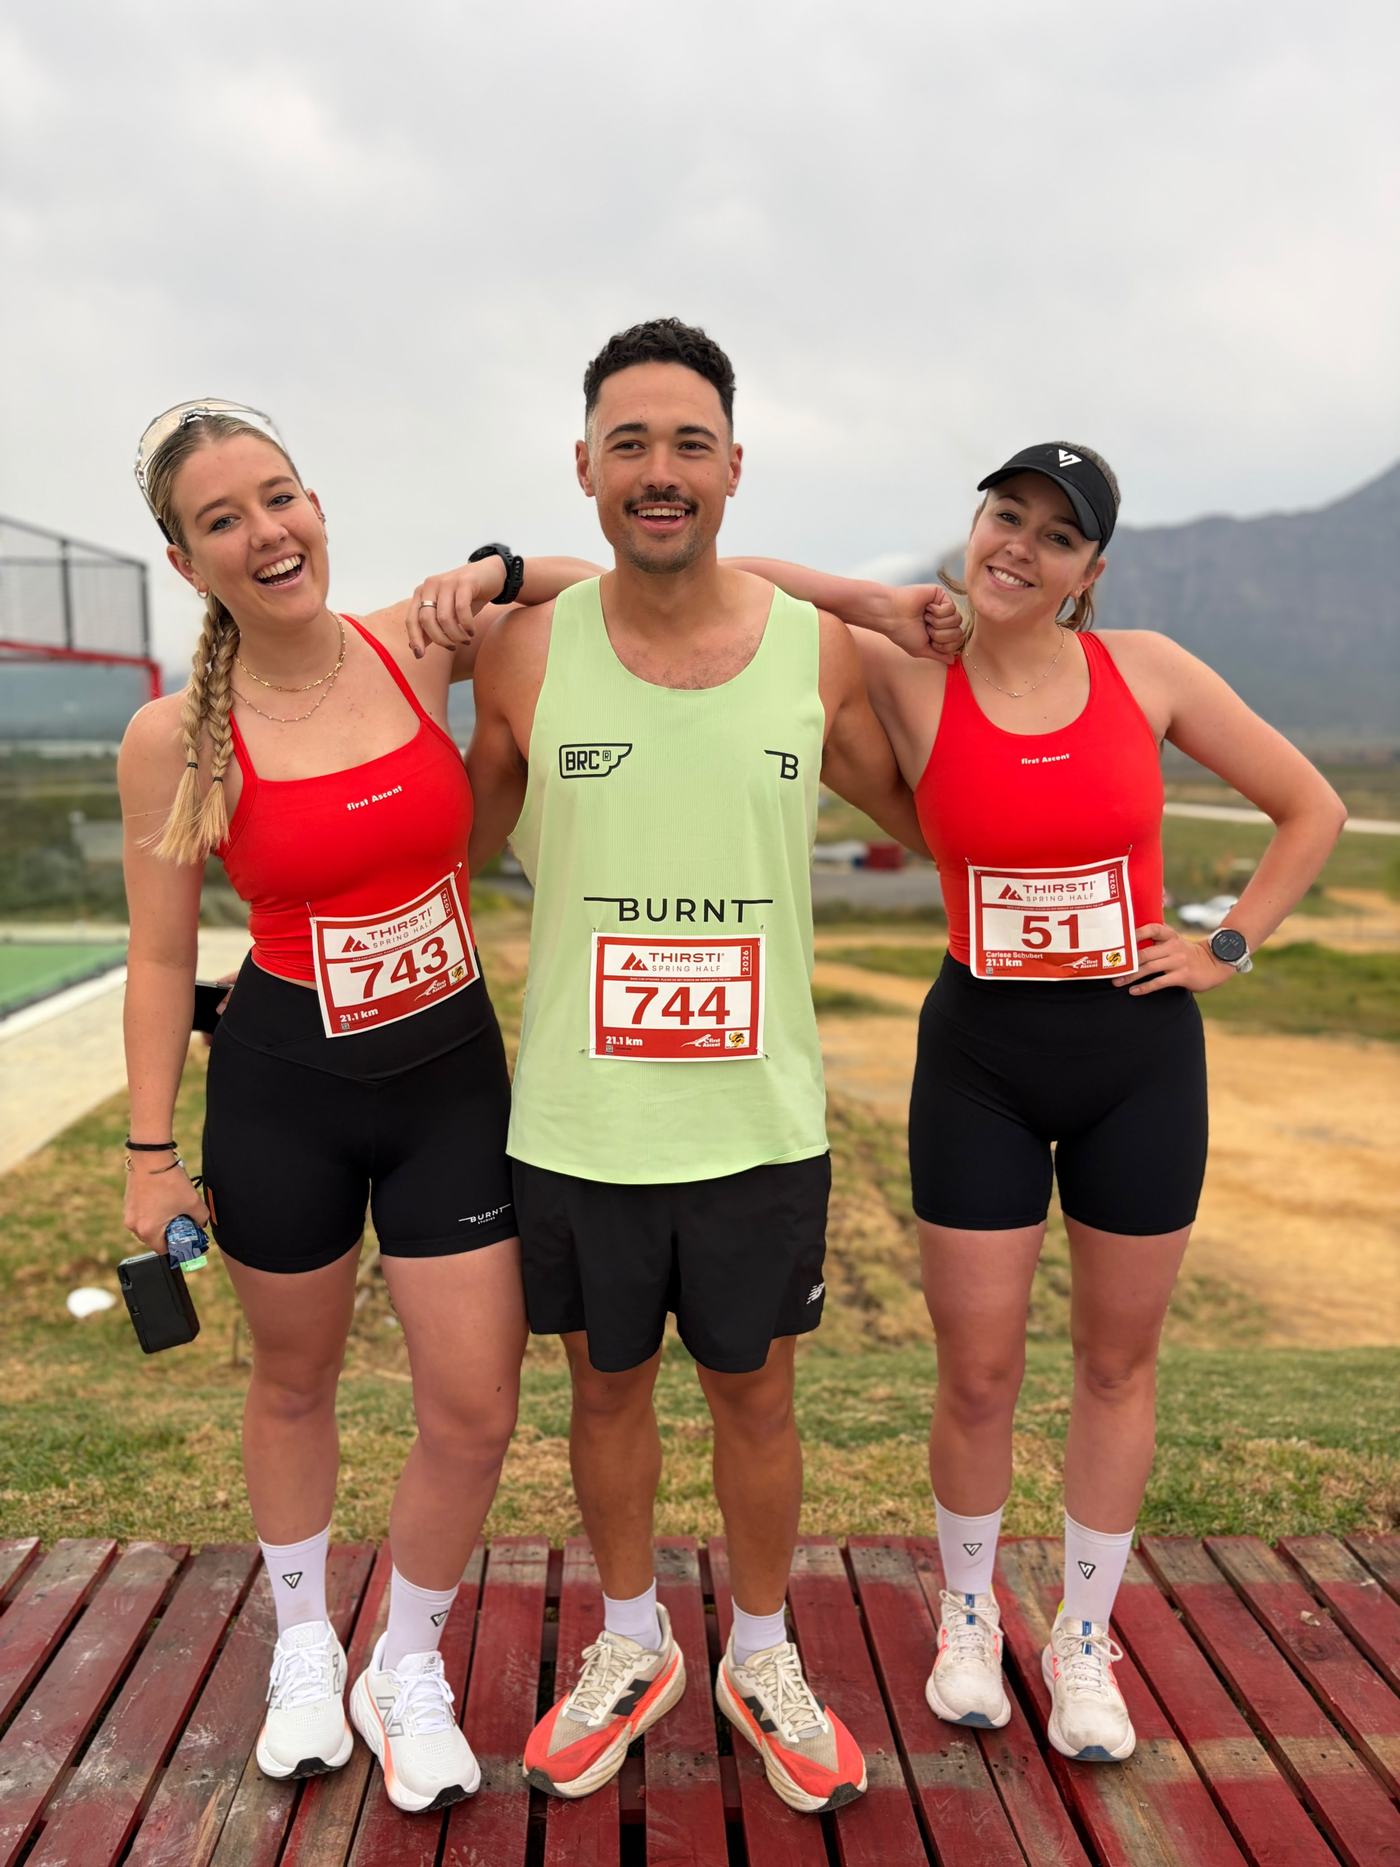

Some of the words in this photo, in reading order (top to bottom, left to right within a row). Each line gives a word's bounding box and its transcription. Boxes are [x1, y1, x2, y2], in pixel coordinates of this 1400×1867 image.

[565, 750, 600, 771] BRC
[1042, 753, 1070, 763] Ascent
[371, 784, 403, 803] Ascent
[1026, 895, 1064, 903] SPRING
[583, 897, 773, 923] BURNT
[372, 931, 409, 949] SPRING
[413, 919, 432, 934] HALF
[1021, 914, 1080, 950] 51
[350, 936, 449, 1000] 743
[985, 958, 1004, 967] 21.1
[1005, 958, 1023, 967] km
[339, 1012, 359, 1023] 21.1
[360, 1008, 379, 1019] km
[625, 986, 731, 1026] 744
[605, 1035, 624, 1045] 21.1
[625, 1036, 643, 1046] km
[458, 1203, 511, 1223] BURNT
